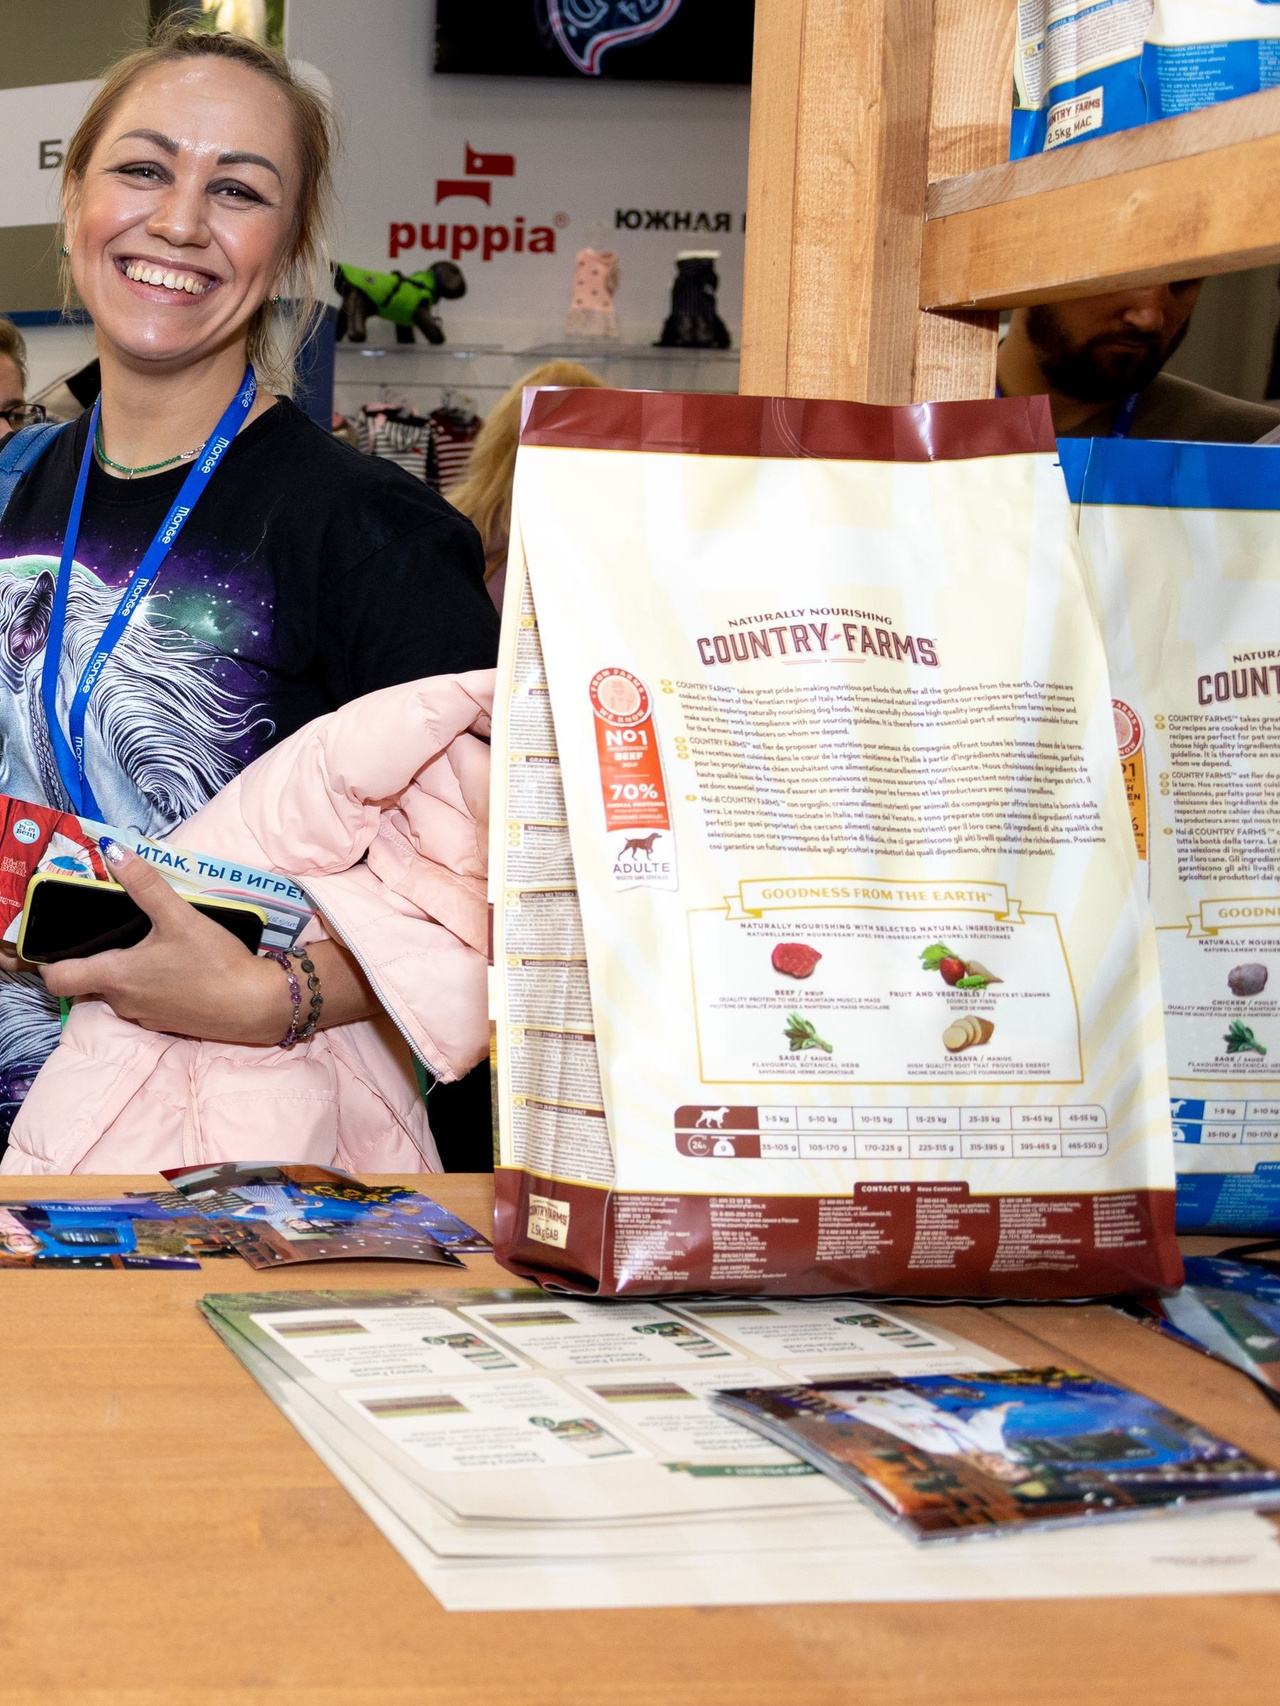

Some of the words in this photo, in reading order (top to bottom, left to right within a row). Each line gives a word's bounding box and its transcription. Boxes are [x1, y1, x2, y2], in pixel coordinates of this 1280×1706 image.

[1075, 98, 1100, 115] FARMS
[202, 437, 229, 474] monge
[162, 506, 190, 544] monge
[122, 578, 149, 617] monge
[727, 608, 805, 628] NATURALLY
[810, 608, 892, 626] NOURISHING
[697, 623, 829, 666] COUNTRY
[842, 623, 939, 667] FARMS
[83, 652, 108, 694] monge
[590, 669, 610, 692] FROM
[614, 669, 644, 694] FARMS
[676, 681, 707, 690] COUNTRY
[737, 687, 754, 695] takes
[755, 687, 774, 695] great
[775, 685, 794, 694] pride
[803, 684, 829, 694] making
[830, 684, 862, 692] nutritious
[873, 685, 889, 694] foods
[943, 685, 978, 695] goodness
[1013, 680, 1032, 688] earth.
[1033, 681, 1045, 689] Our
[599, 707, 614, 722] WE
[618, 709, 644, 723] KNOW
[614, 752, 643, 761] BEEF
[610, 784, 658, 800] 70%
[16, 828, 36, 839] Bent
[136, 844, 191, 873] ИТАК,
[197, 862, 225, 879] ТЫ
[229, 870, 243, 882] В
[246, 874, 305, 900] ИГРЕ!
[613, 863, 670, 874] ADULTE
[762, 887, 850, 900] GOODNESS
[854, 889, 893, 900] FROM
[897, 890, 929, 902] THE
[740, 922, 792, 930] NATURALLY
[795, 923, 851, 931] NOURISHING
[920, 924, 963, 932] NATURAL
[966, 925, 1015, 933] INGREDIENTS
[766, 1115, 777, 1123] 1-5
[779, 1115, 789, 1124] kg
[809, 1115, 825, 1123] 5-10
[828, 1115, 837, 1125] kg
[883, 1116, 893, 1125] kg
[938, 1116, 947, 1125] kg
[991, 1116, 1000, 1124] kg
[1044, 1115, 1052, 1124] kg
[1090, 1115, 1098, 1123] kg
[809, 1143, 840, 1151] 105-170
[861, 1185, 898, 1193] CONTACT
[900, 1185, 911, 1193] US
